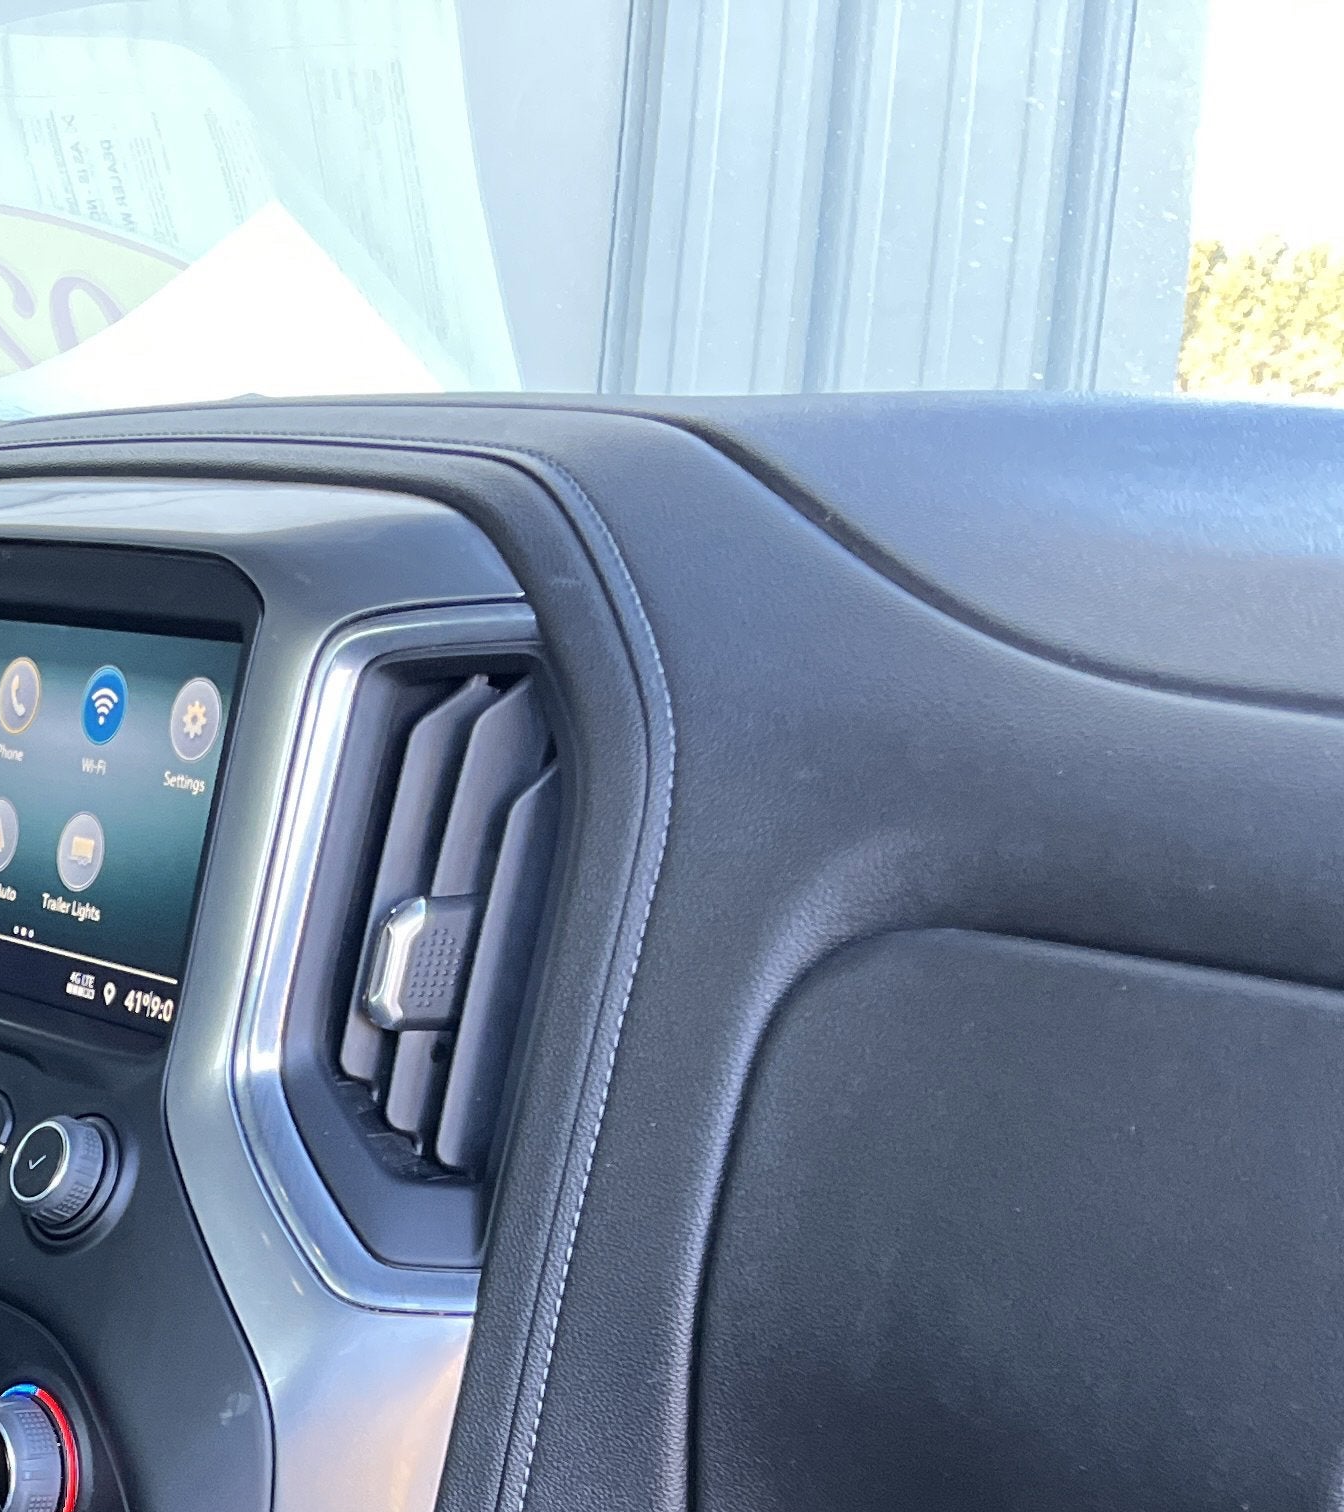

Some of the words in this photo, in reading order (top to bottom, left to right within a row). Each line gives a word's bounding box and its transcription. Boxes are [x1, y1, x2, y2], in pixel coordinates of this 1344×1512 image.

[81, 757, 107, 775] Wi-Fi
[163, 770, 206, 795] Settings
[41, 892, 71, 914] Trailer
[71, 900, 101, 922] Lights
